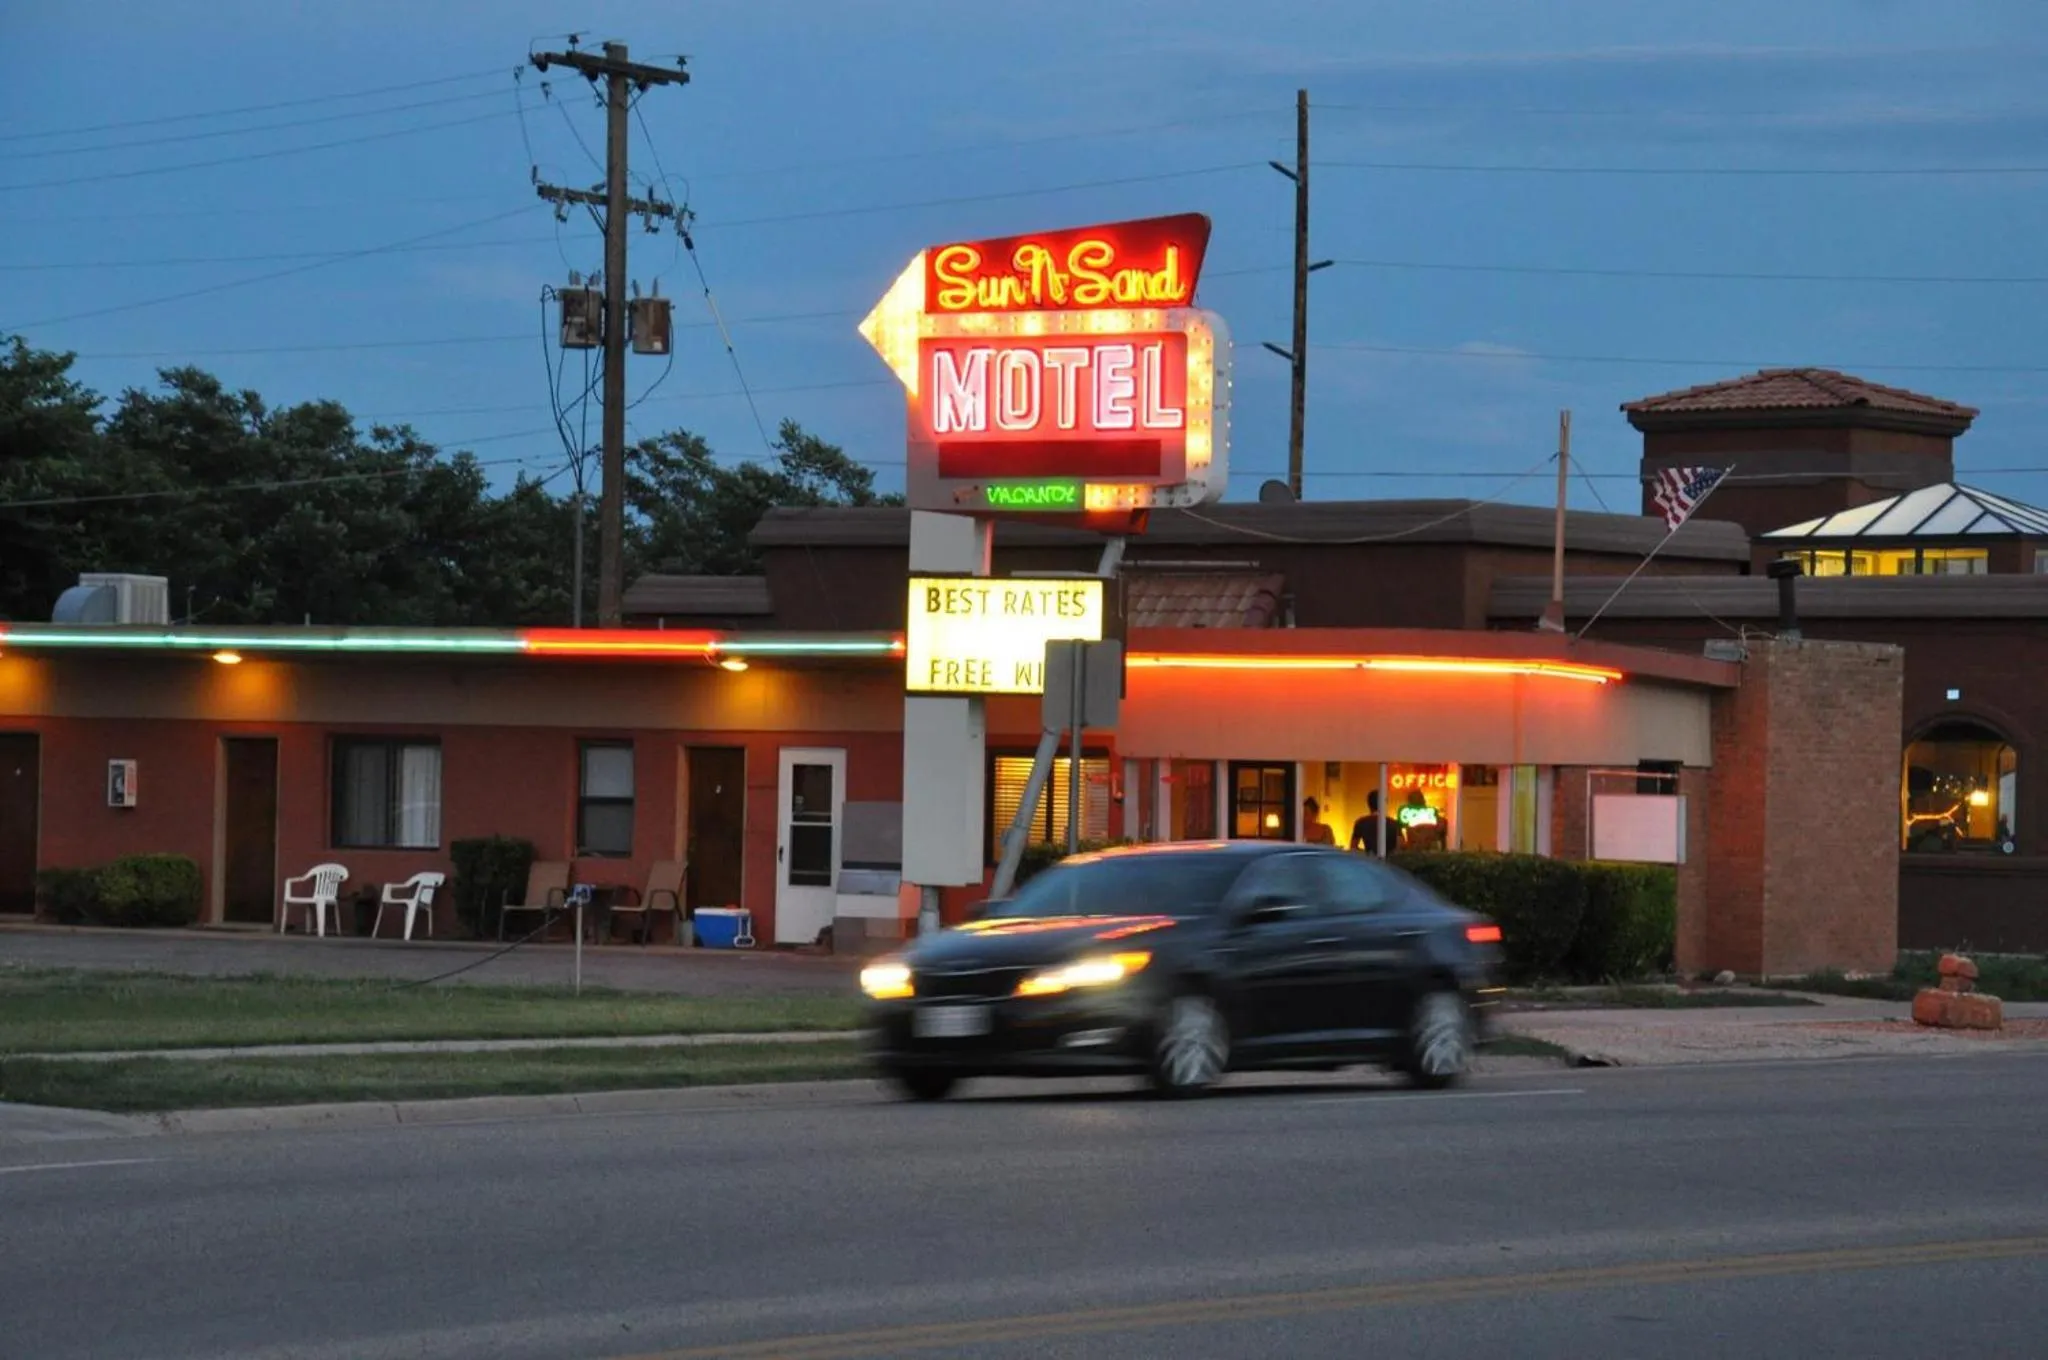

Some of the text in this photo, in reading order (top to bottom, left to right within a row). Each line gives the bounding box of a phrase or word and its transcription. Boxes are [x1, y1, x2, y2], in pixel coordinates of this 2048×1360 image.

[935, 244, 1026, 309] Sun
[1067, 239, 1185, 305] Sand
[932, 340, 1184, 433] MOTEL
[986, 486, 1076, 504] VACANCY
[926, 586, 1086, 617] BEST RATES
[930, 658, 993, 686] FREE
